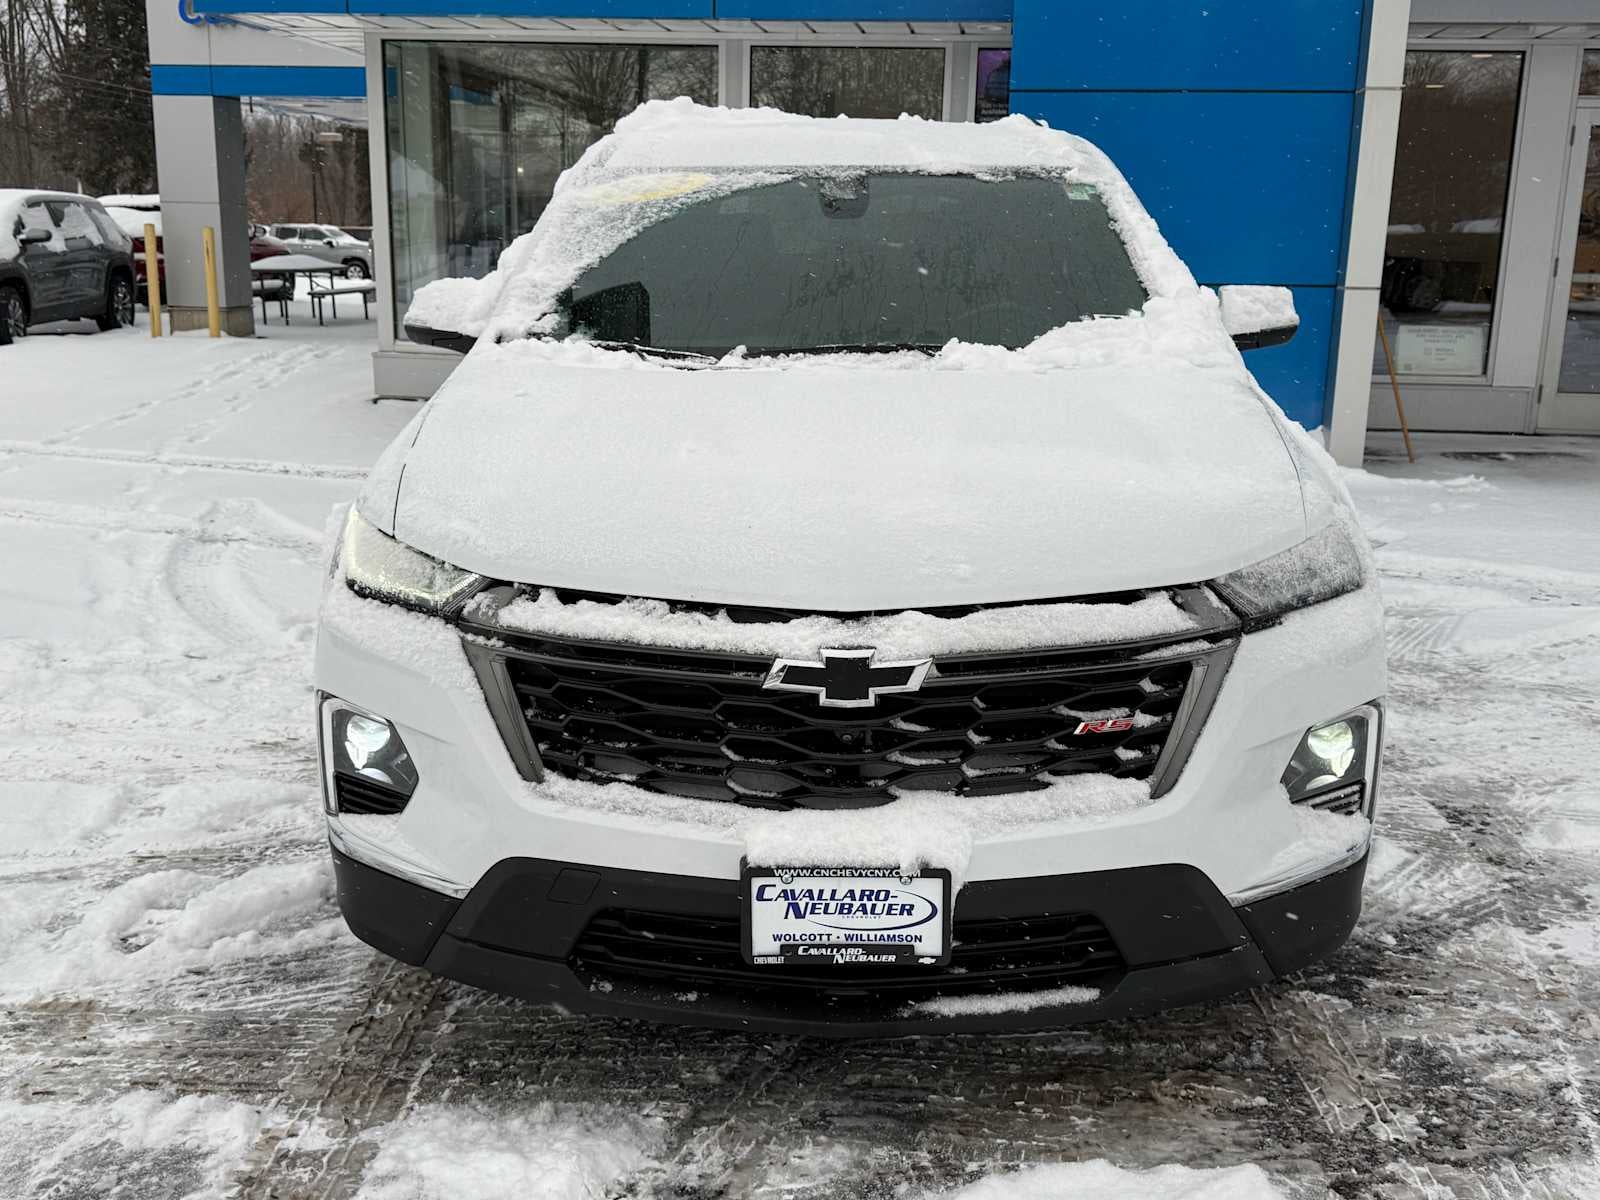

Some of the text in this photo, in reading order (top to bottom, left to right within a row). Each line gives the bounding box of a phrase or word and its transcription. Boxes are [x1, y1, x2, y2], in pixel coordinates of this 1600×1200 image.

[1073, 717, 1134, 735] RS
[755, 884, 898, 901] CAVALLARO-
[784, 902, 915, 919] NEUBAUER
[772, 933, 923, 943] WOLCOTT WILLIAMSON
[754, 956, 785, 964] CHEVROLET
[832, 954, 897, 964] NEUBAUER
